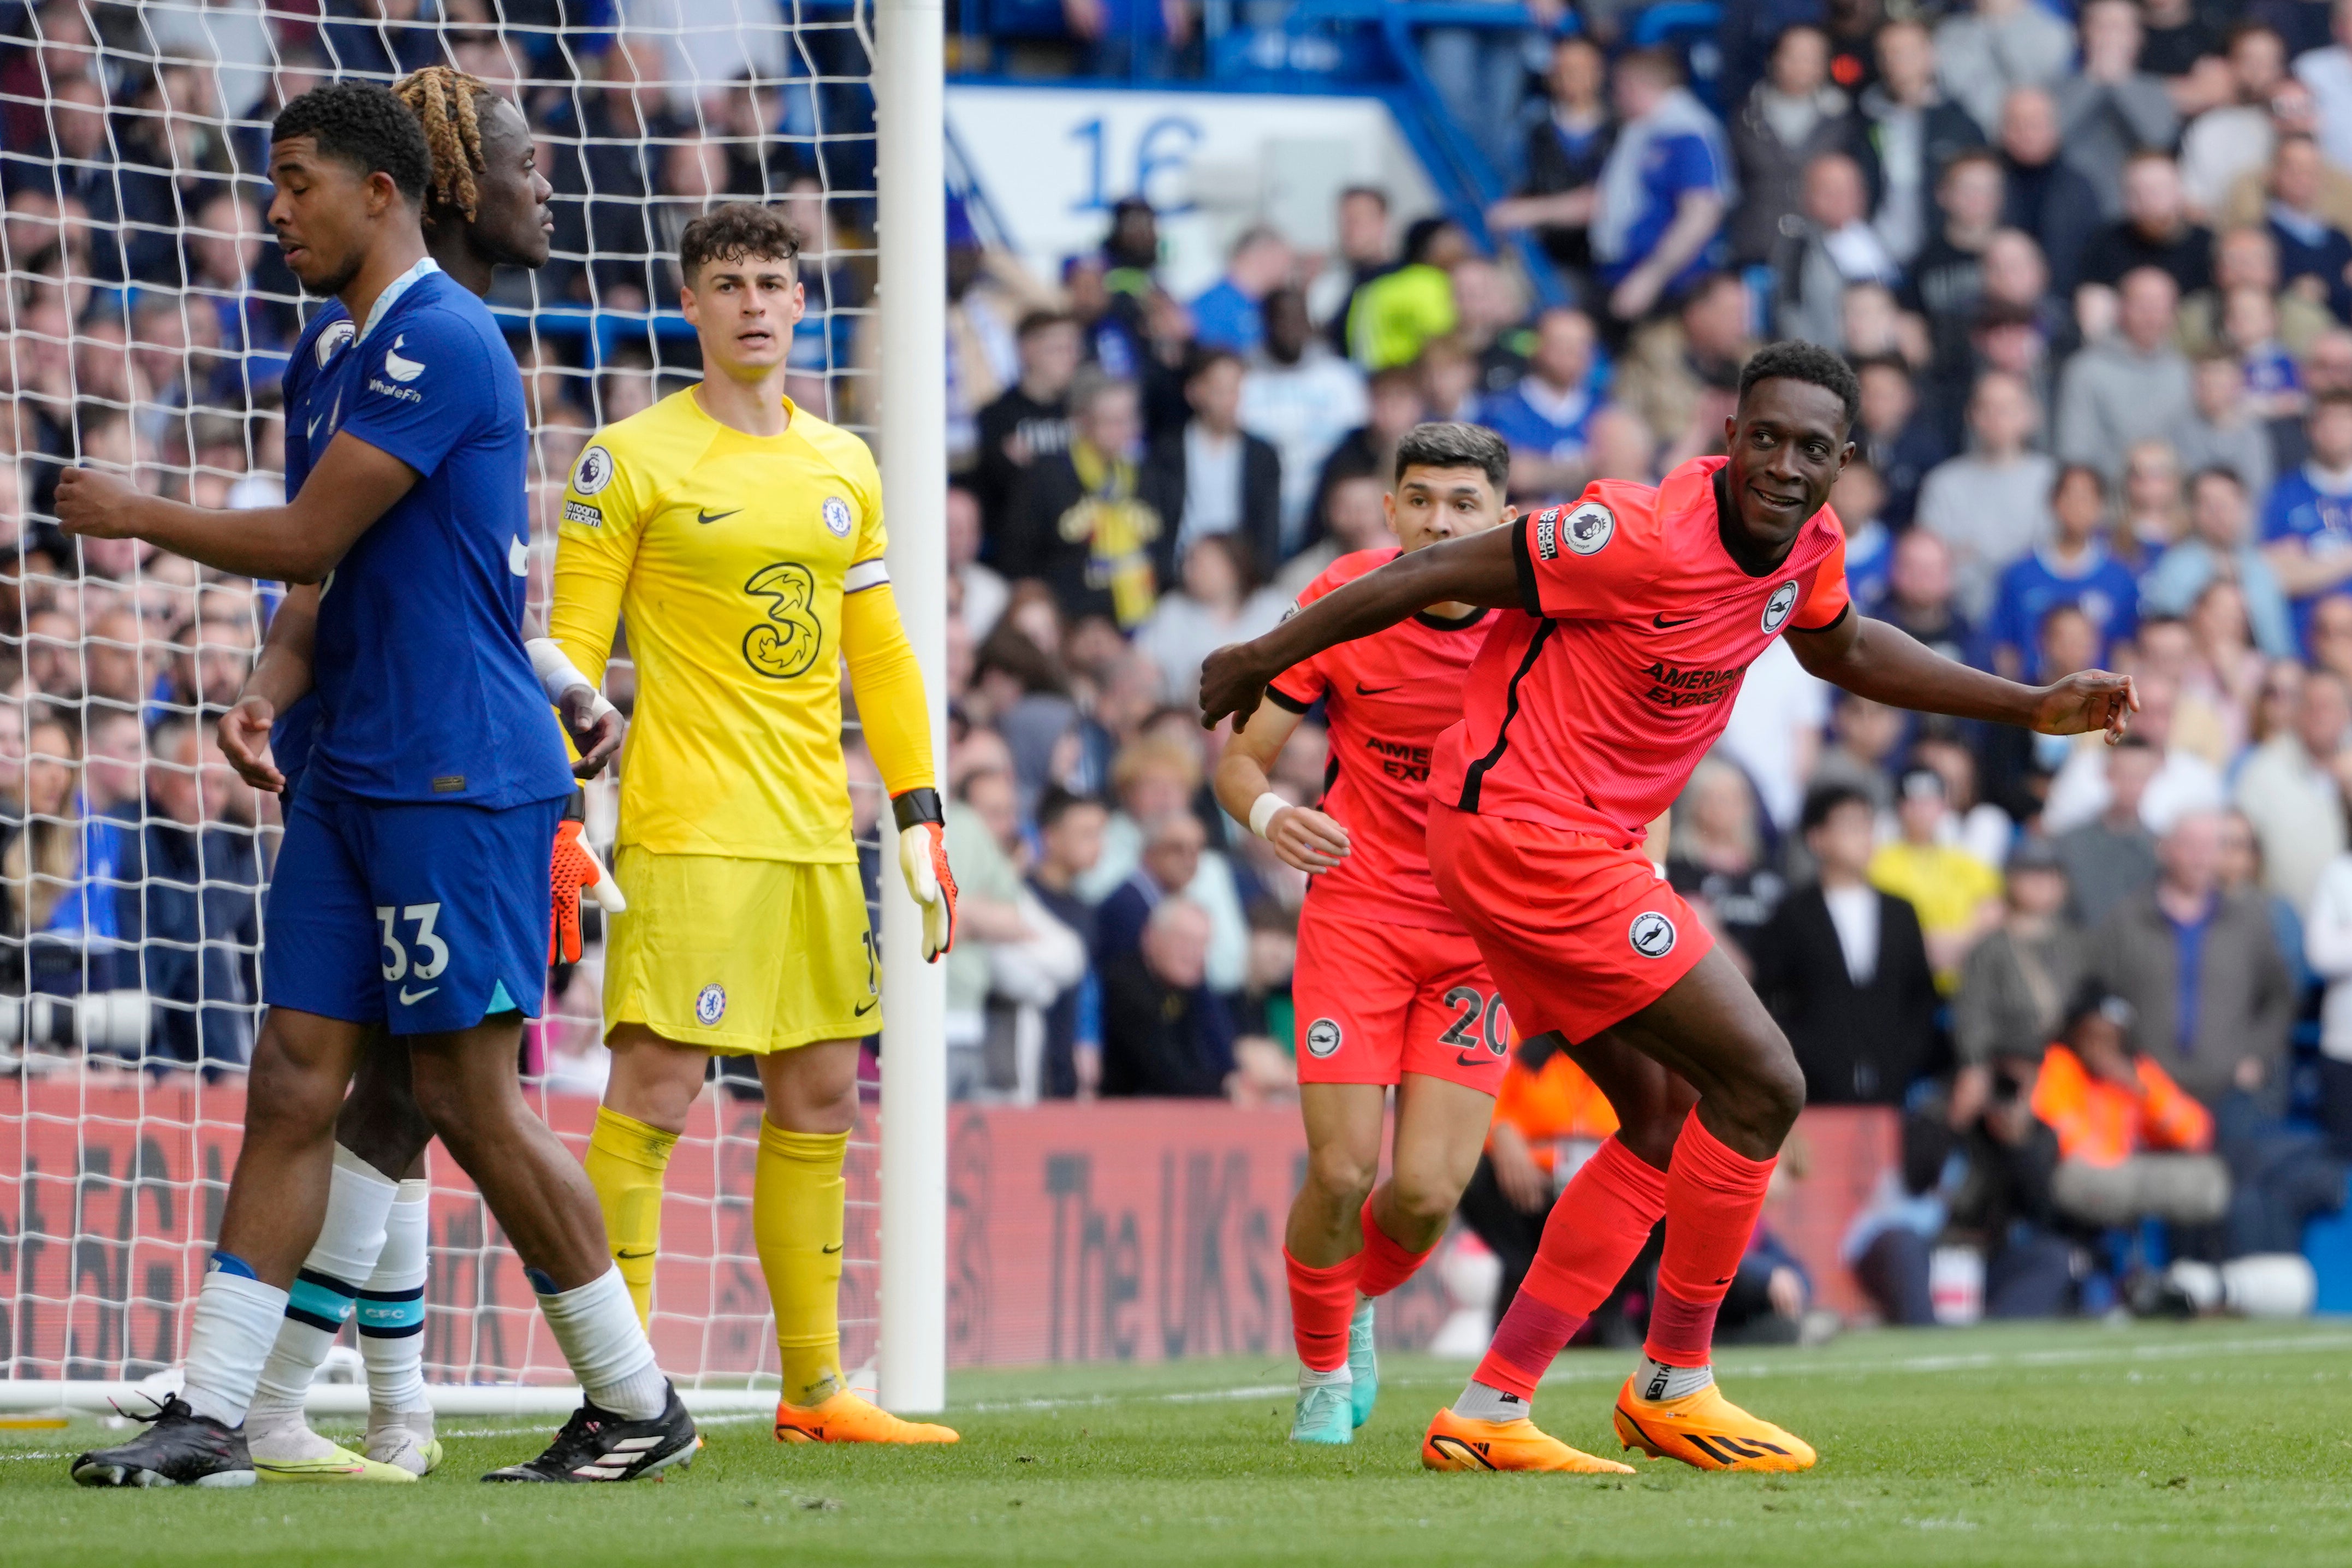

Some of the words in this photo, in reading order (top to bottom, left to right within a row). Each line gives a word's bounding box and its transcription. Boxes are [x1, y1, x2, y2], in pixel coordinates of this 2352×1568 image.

[1068, 114, 1203, 214] 16
[1537, 522, 1549, 561] racism
[1545, 522, 1556, 554] room
[742, 562, 821, 679] 3
[376, 902, 449, 981] 33
[1437, 985, 1509, 1056] 20
[1044, 1153, 1141, 1359] The
[365, 1308, 405, 1320] CFC
